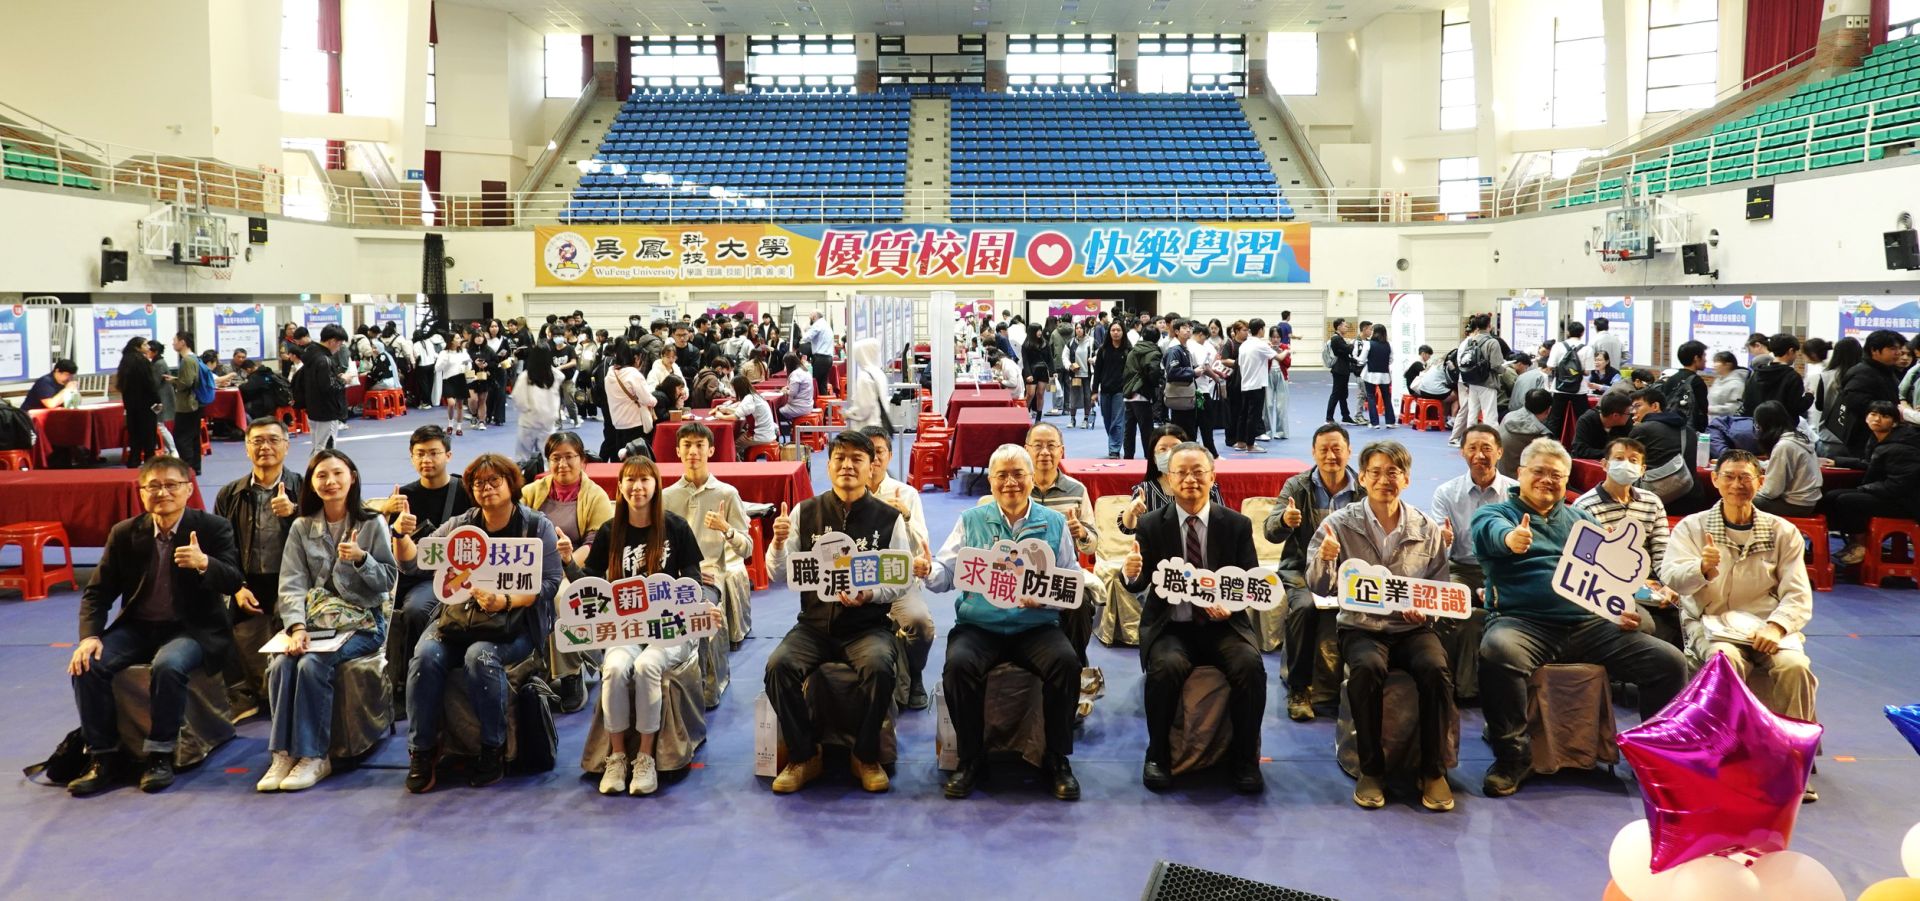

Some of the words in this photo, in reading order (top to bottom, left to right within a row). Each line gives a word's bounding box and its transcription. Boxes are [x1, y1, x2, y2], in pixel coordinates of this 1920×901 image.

[816, 228, 1016, 278] 優質校園
[1085, 228, 1283, 277] 快樂學習
[595, 268, 631, 278] WuFeng
[633, 268, 676, 278] University
[422, 536, 535, 567] 求職技巧
[477, 572, 533, 591] 一把抓
[792, 557, 907, 597] 職涯諮詢
[960, 556, 1077, 604] 求職防騙
[1162, 567, 1273, 604] 職場體驗
[1354, 577, 1468, 615] 企業認識
[1558, 562, 1627, 618] Like
[569, 579, 698, 620] 徵薪誠意
[596, 610, 712, 643] 勇往職前
